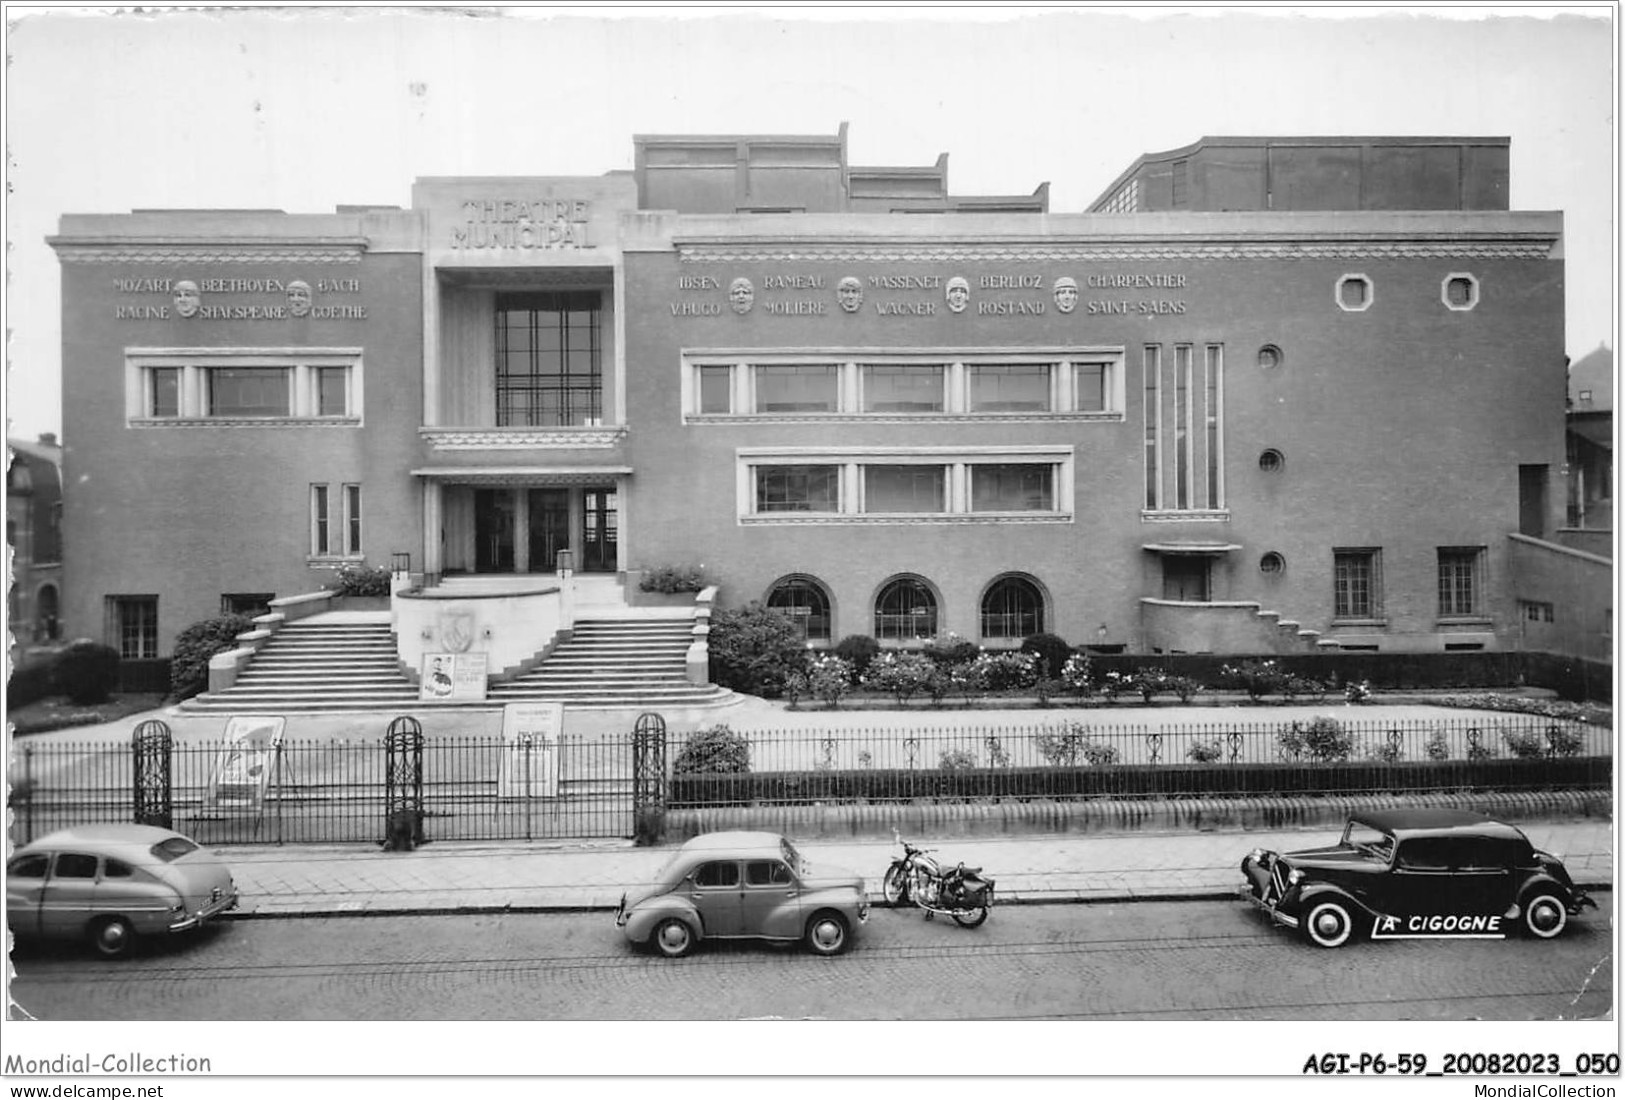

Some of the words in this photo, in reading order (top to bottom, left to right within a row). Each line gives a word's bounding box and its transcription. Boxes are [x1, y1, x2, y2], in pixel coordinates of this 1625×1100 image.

[462, 200, 589, 224] THEATRE
[451, 225, 597, 250] MUNICIPAL
[113, 278, 172, 292] MOZART
[202, 278, 285, 293] BEETHOVEN
[319, 278, 360, 292] BACH
[679, 276, 721, 290] IBSEN
[764, 275, 826, 289] RAMEAU
[868, 275, 942, 290] MASSENET
[980, 275, 1043, 289] BERLIOZ
[1088, 274, 1187, 289] CHARPENTIER
[115, 306, 170, 320] RACINE
[200, 305, 287, 320] SHAKSPEARE
[312, 305, 368, 319] GOETHE
[764, 301, 827, 316] MOLIERE
[876, 302, 936, 317] WAGNER
[978, 301, 1046, 316] ROSTAND
